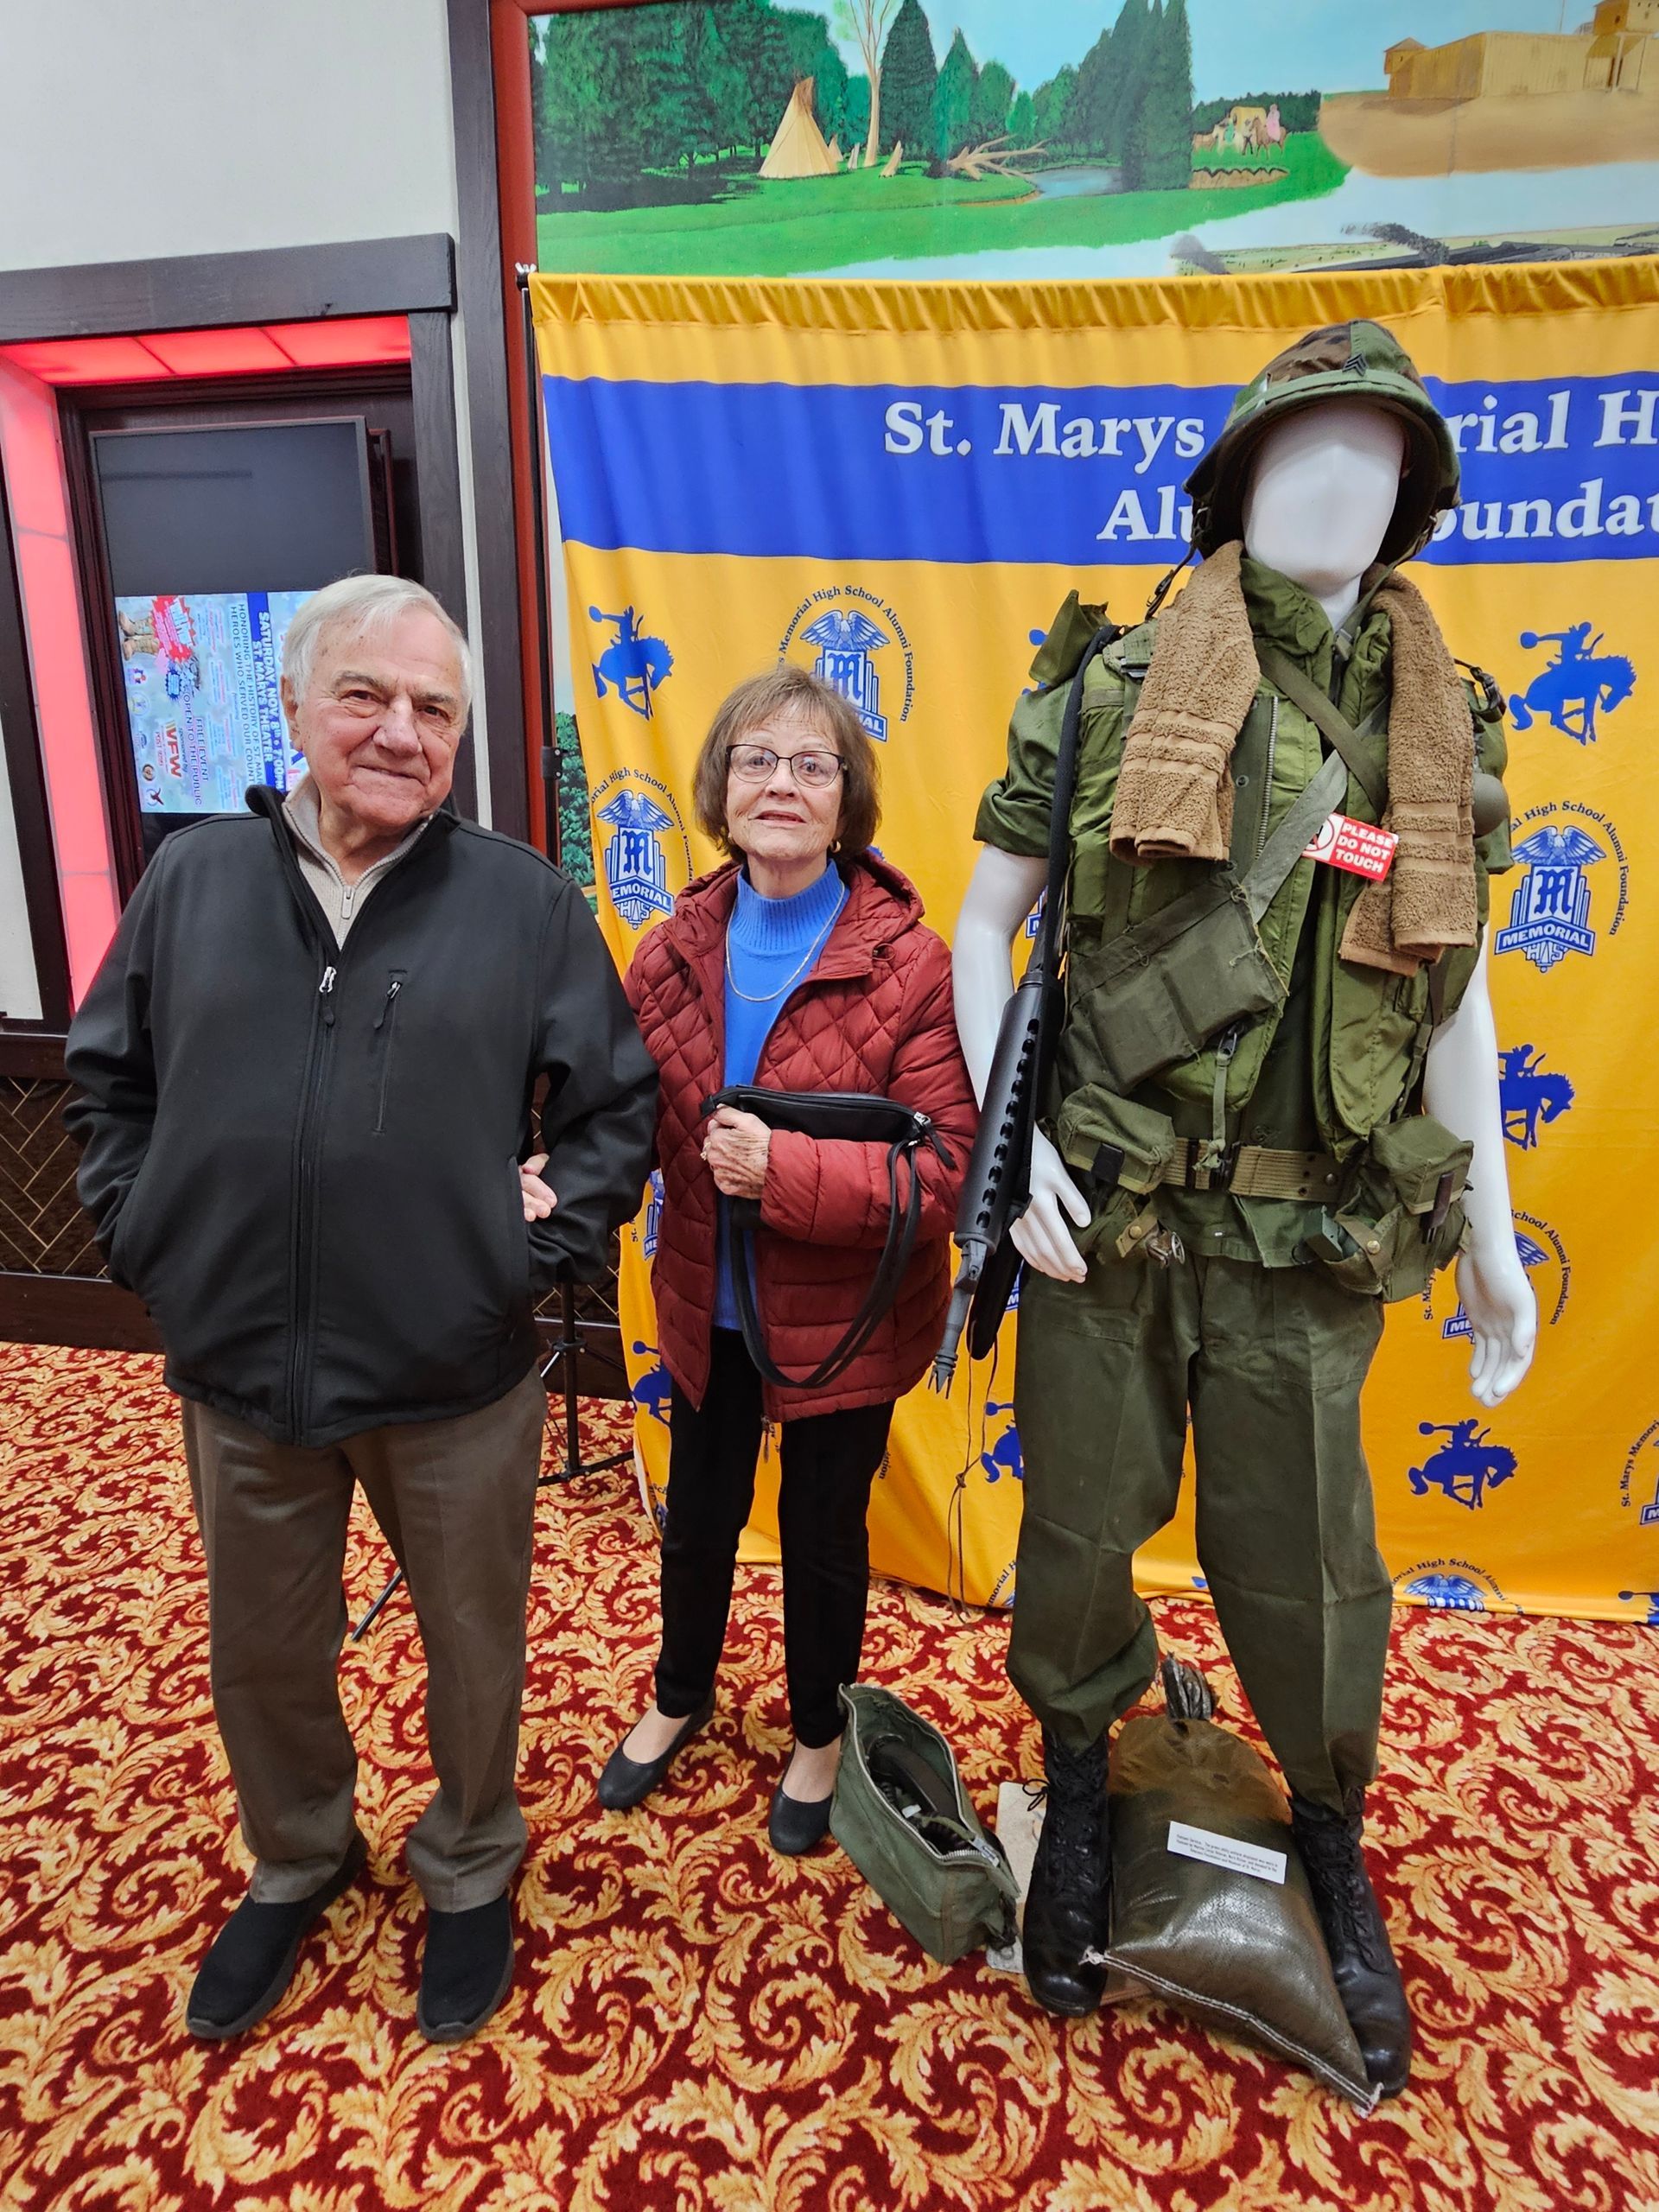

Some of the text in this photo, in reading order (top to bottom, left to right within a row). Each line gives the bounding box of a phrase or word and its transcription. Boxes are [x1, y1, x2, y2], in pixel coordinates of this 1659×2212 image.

[885, 402, 973, 456] St.
[993, 402, 1205, 474] Marys
[1445, 390, 1571, 454] rial
[238, 604, 251, 661] HONORING
[779, 585, 915, 722] Memorial High School Alumni Foundation
[230, 607, 256, 783] HEROES WHO SERVED OUR COUNT
[245, 664, 254, 682] THE
[247, 684, 258, 728] HISTORY
[166, 727, 182, 778] VFW
[182, 694, 202, 805] OPEN TO THE PUBLIC
[195, 718, 209, 782] FREE EVENT
[251, 731, 258, 743] OF
[258, 708, 272, 762] THEATER
[591, 779, 609, 804] orial
[609, 767, 631, 784] High
[633, 768, 667, 794] School
[666, 793, 686, 832] Alumni
[1338, 835, 1390, 861] DO NOT
[1340, 823, 1393, 849] PLEASE
[1335, 849, 1384, 873] TOUCH
[1524, 800, 1630, 936] High School Alumni Foundation
[612, 882, 673, 909] EMORIAL
[1502, 922, 1590, 949] MEMORIAL
[1544, 1228, 1570, 1264] Alumni
[1423, 1302, 1433, 1320] St.
[1549, 1266, 1572, 1325] Foundation
[1620, 1419, 1659, 1507] St. Marys Memori
[988, 1569, 1010, 1605] morial
[1393, 1558, 1509, 1601] orial High School Alumni
